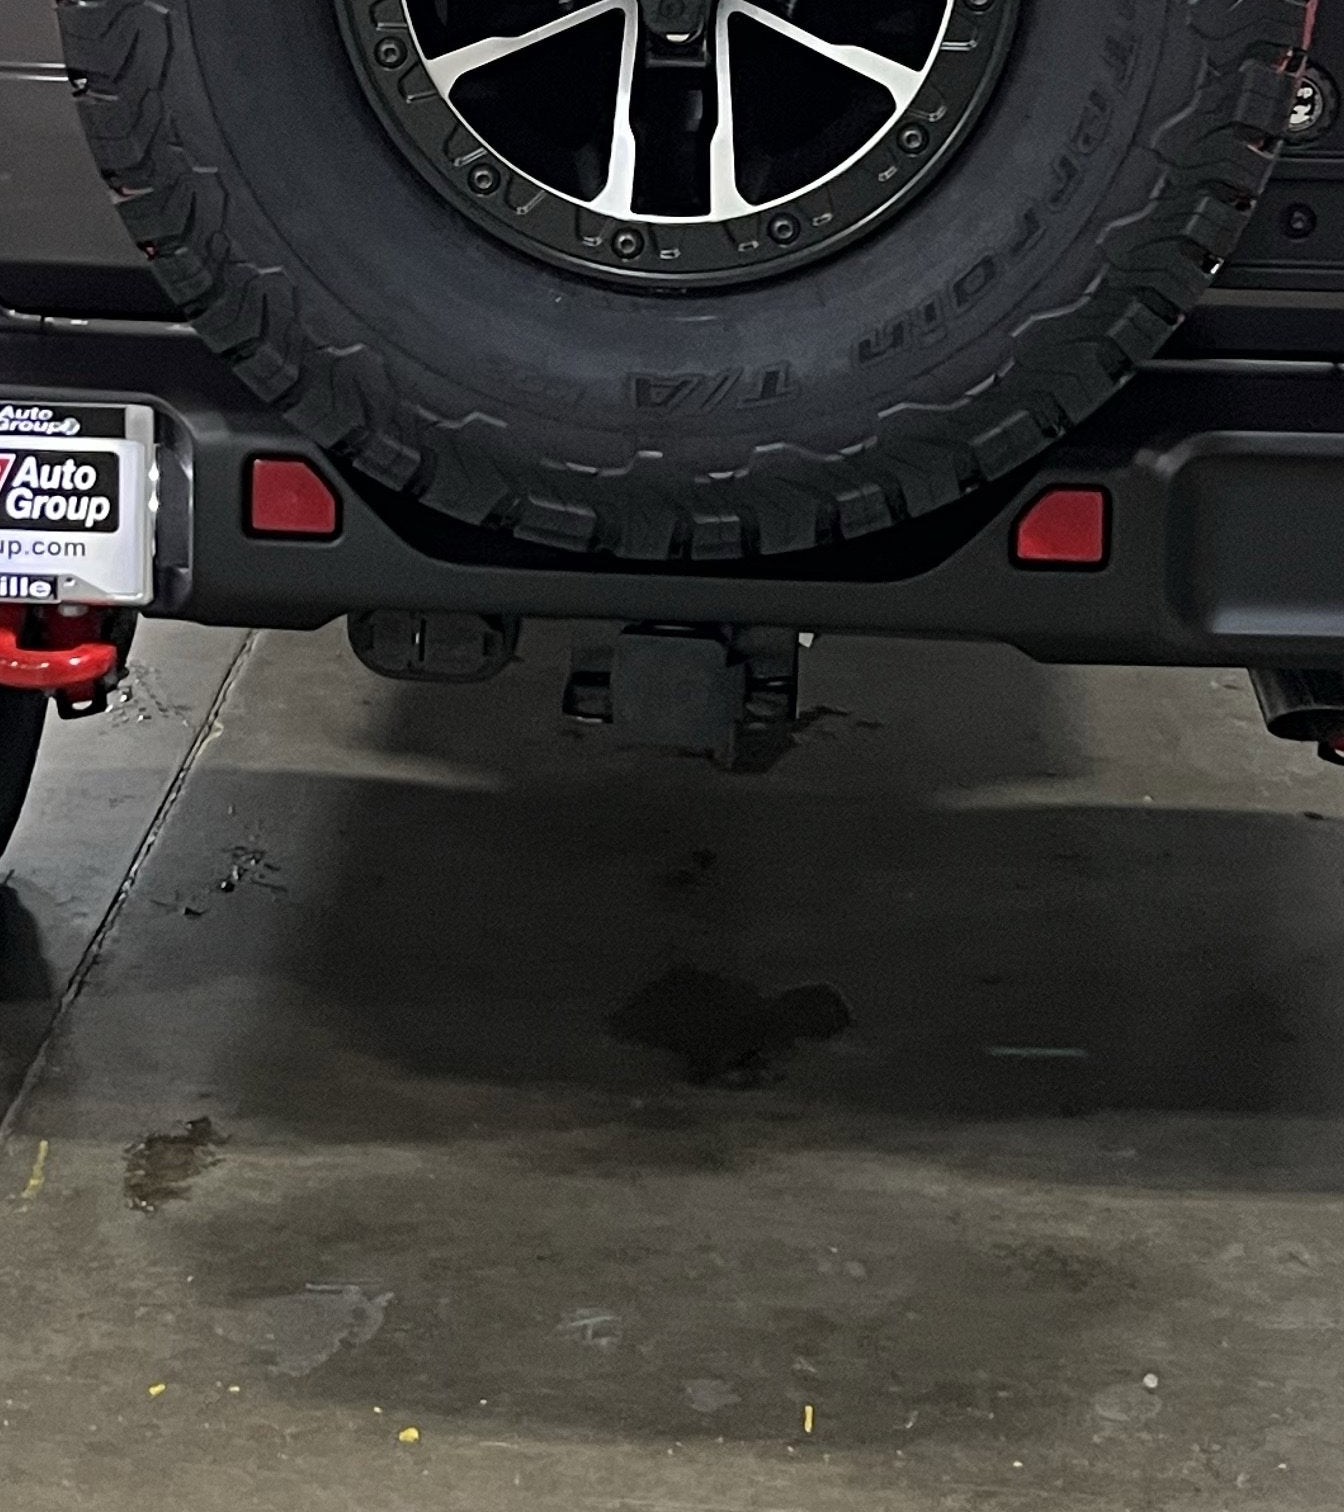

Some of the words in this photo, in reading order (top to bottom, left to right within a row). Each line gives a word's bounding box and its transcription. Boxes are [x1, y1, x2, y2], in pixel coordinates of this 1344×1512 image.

[2, 405, 54, 421] Auto
[11, 455, 97, 491] Auto
[5, 487, 112, 528] Group
